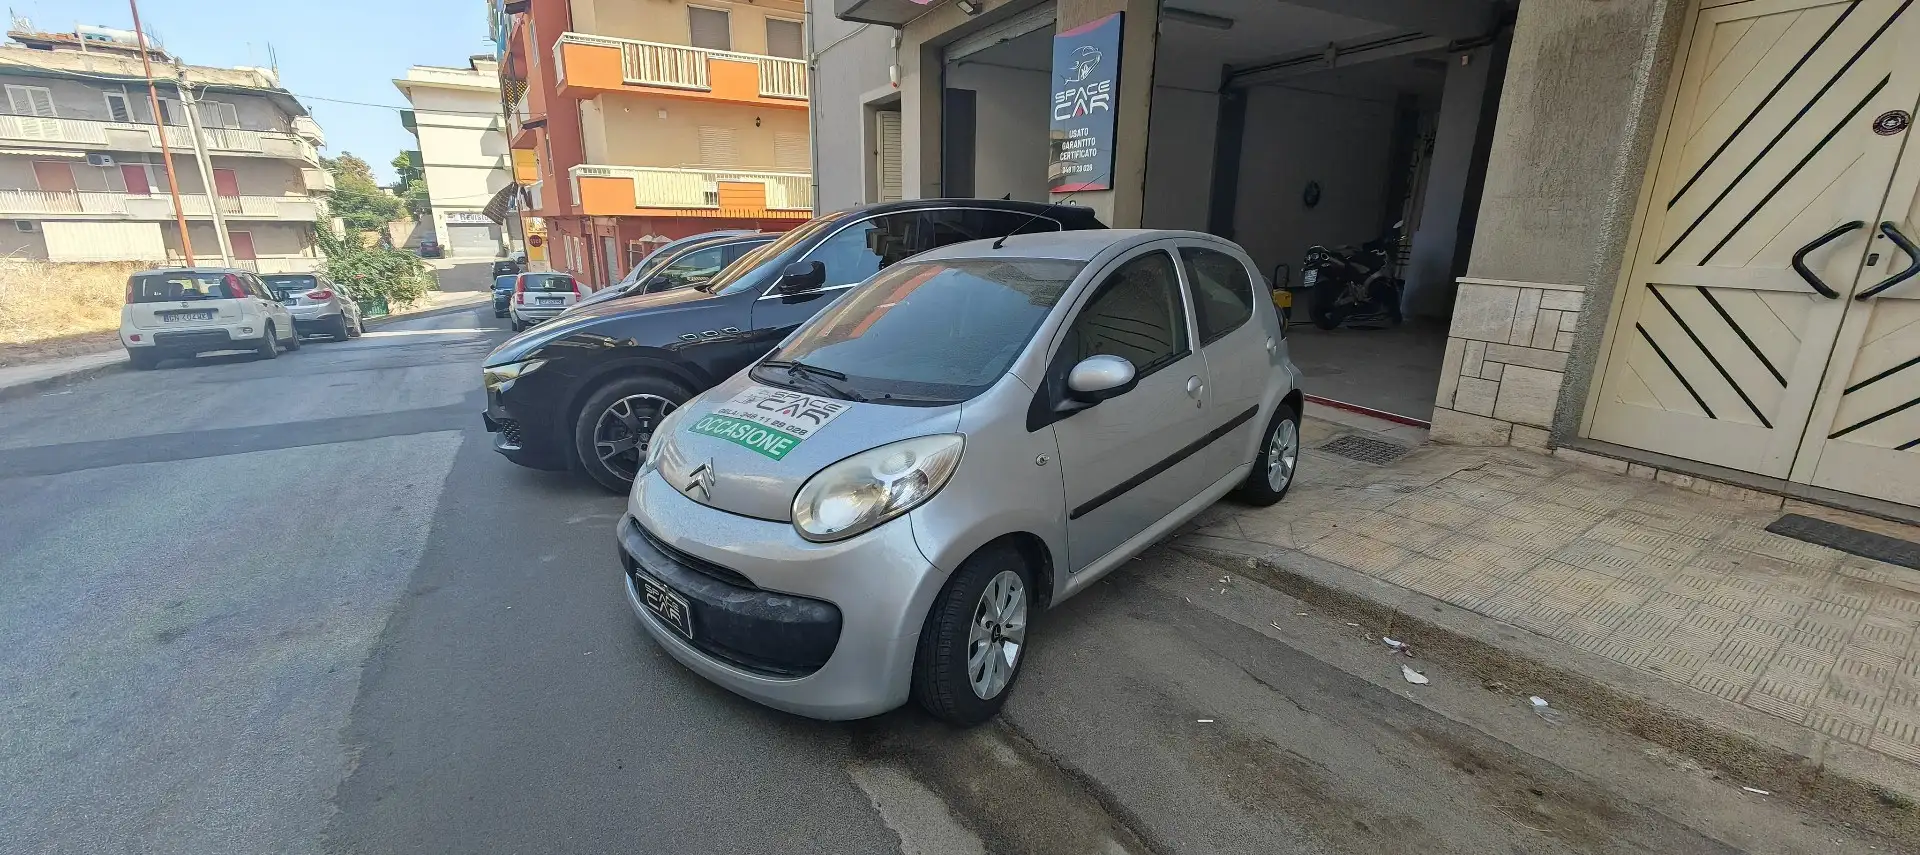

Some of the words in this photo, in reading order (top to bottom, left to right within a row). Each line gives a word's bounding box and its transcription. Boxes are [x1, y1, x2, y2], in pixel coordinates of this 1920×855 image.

[1055, 80, 1111, 103] SPACE
[1054, 94, 1110, 121] CAR
[1061, 137, 1096, 150] GARANTITO
[1069, 128, 1089, 138] USATO
[1060, 148, 1097, 160] CERTIFICATO
[756, 398, 830, 425] CAR
[771, 391, 843, 413] SPACE
[696, 416, 794, 456] OCCASIONE
[786, 425, 809, 436] 028
[645, 583, 680, 613] SPACE
[647, 592, 683, 627] CAR
